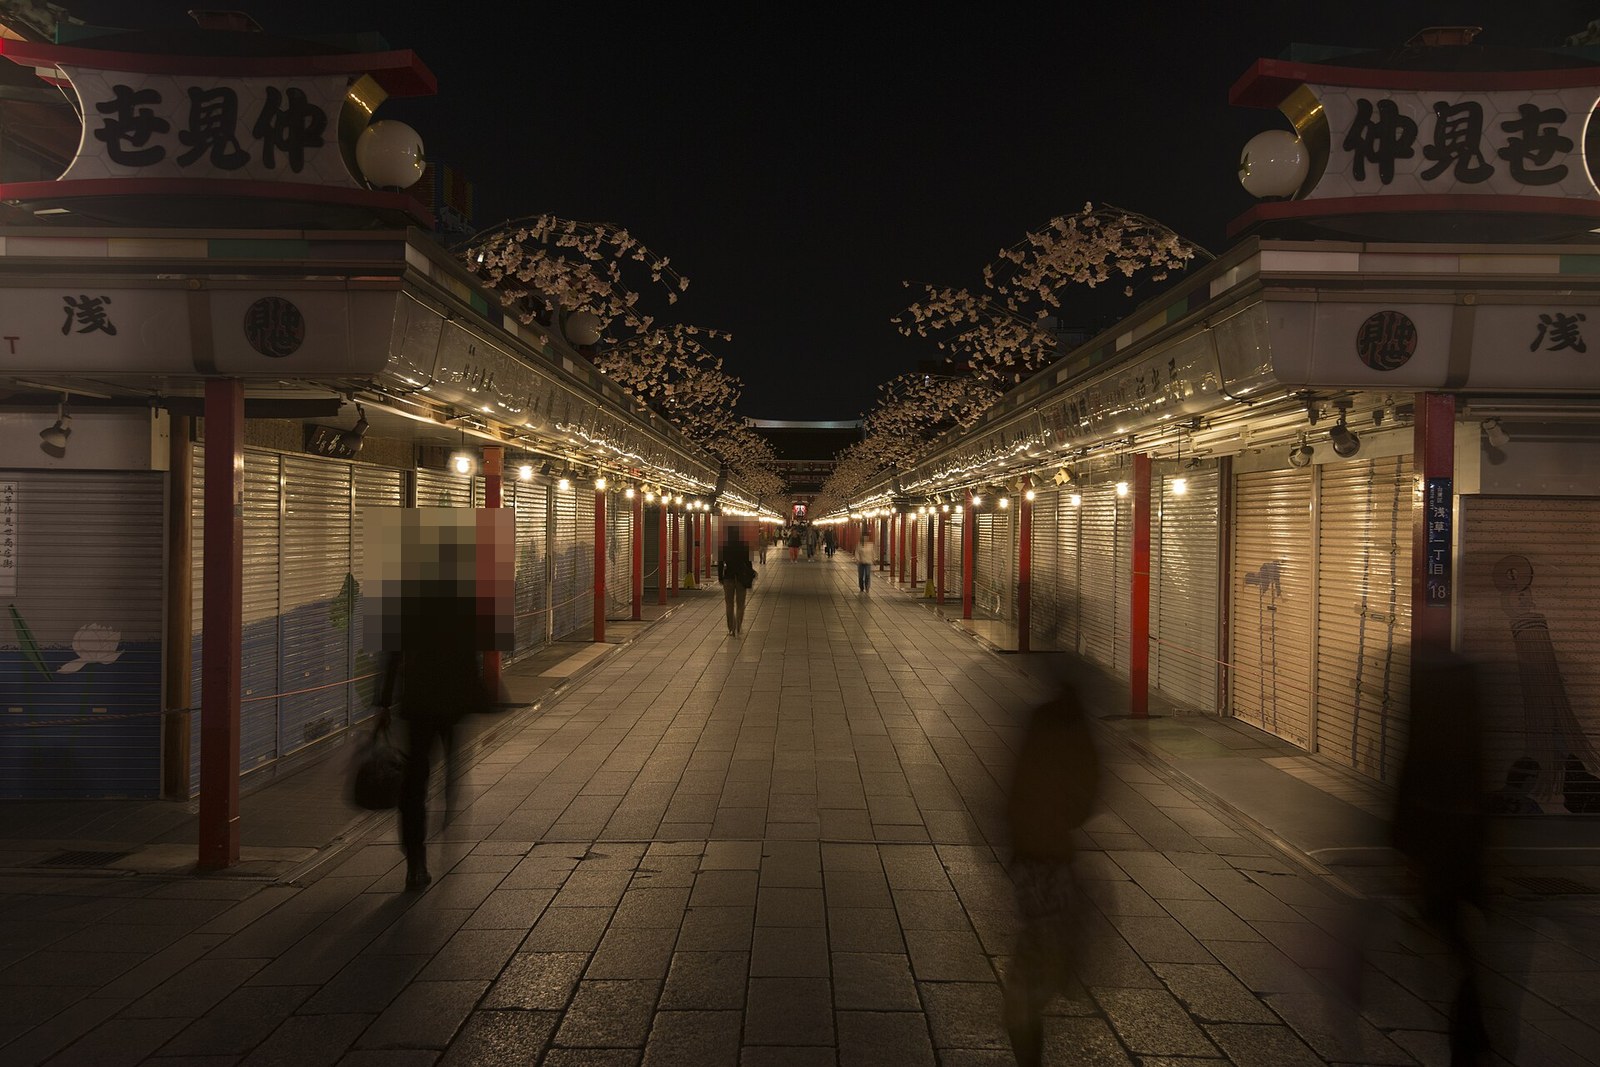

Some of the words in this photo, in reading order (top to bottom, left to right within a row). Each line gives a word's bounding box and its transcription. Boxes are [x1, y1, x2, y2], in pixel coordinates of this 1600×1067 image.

[1343, 98, 1574, 186] 仲見世
[62, 294, 117, 336] 浅
[1530, 313, 1587, 354] 浅
[1433, 507, 1446, 575] 浅草一丁目
[1430, 585, 1446, 599] 18
